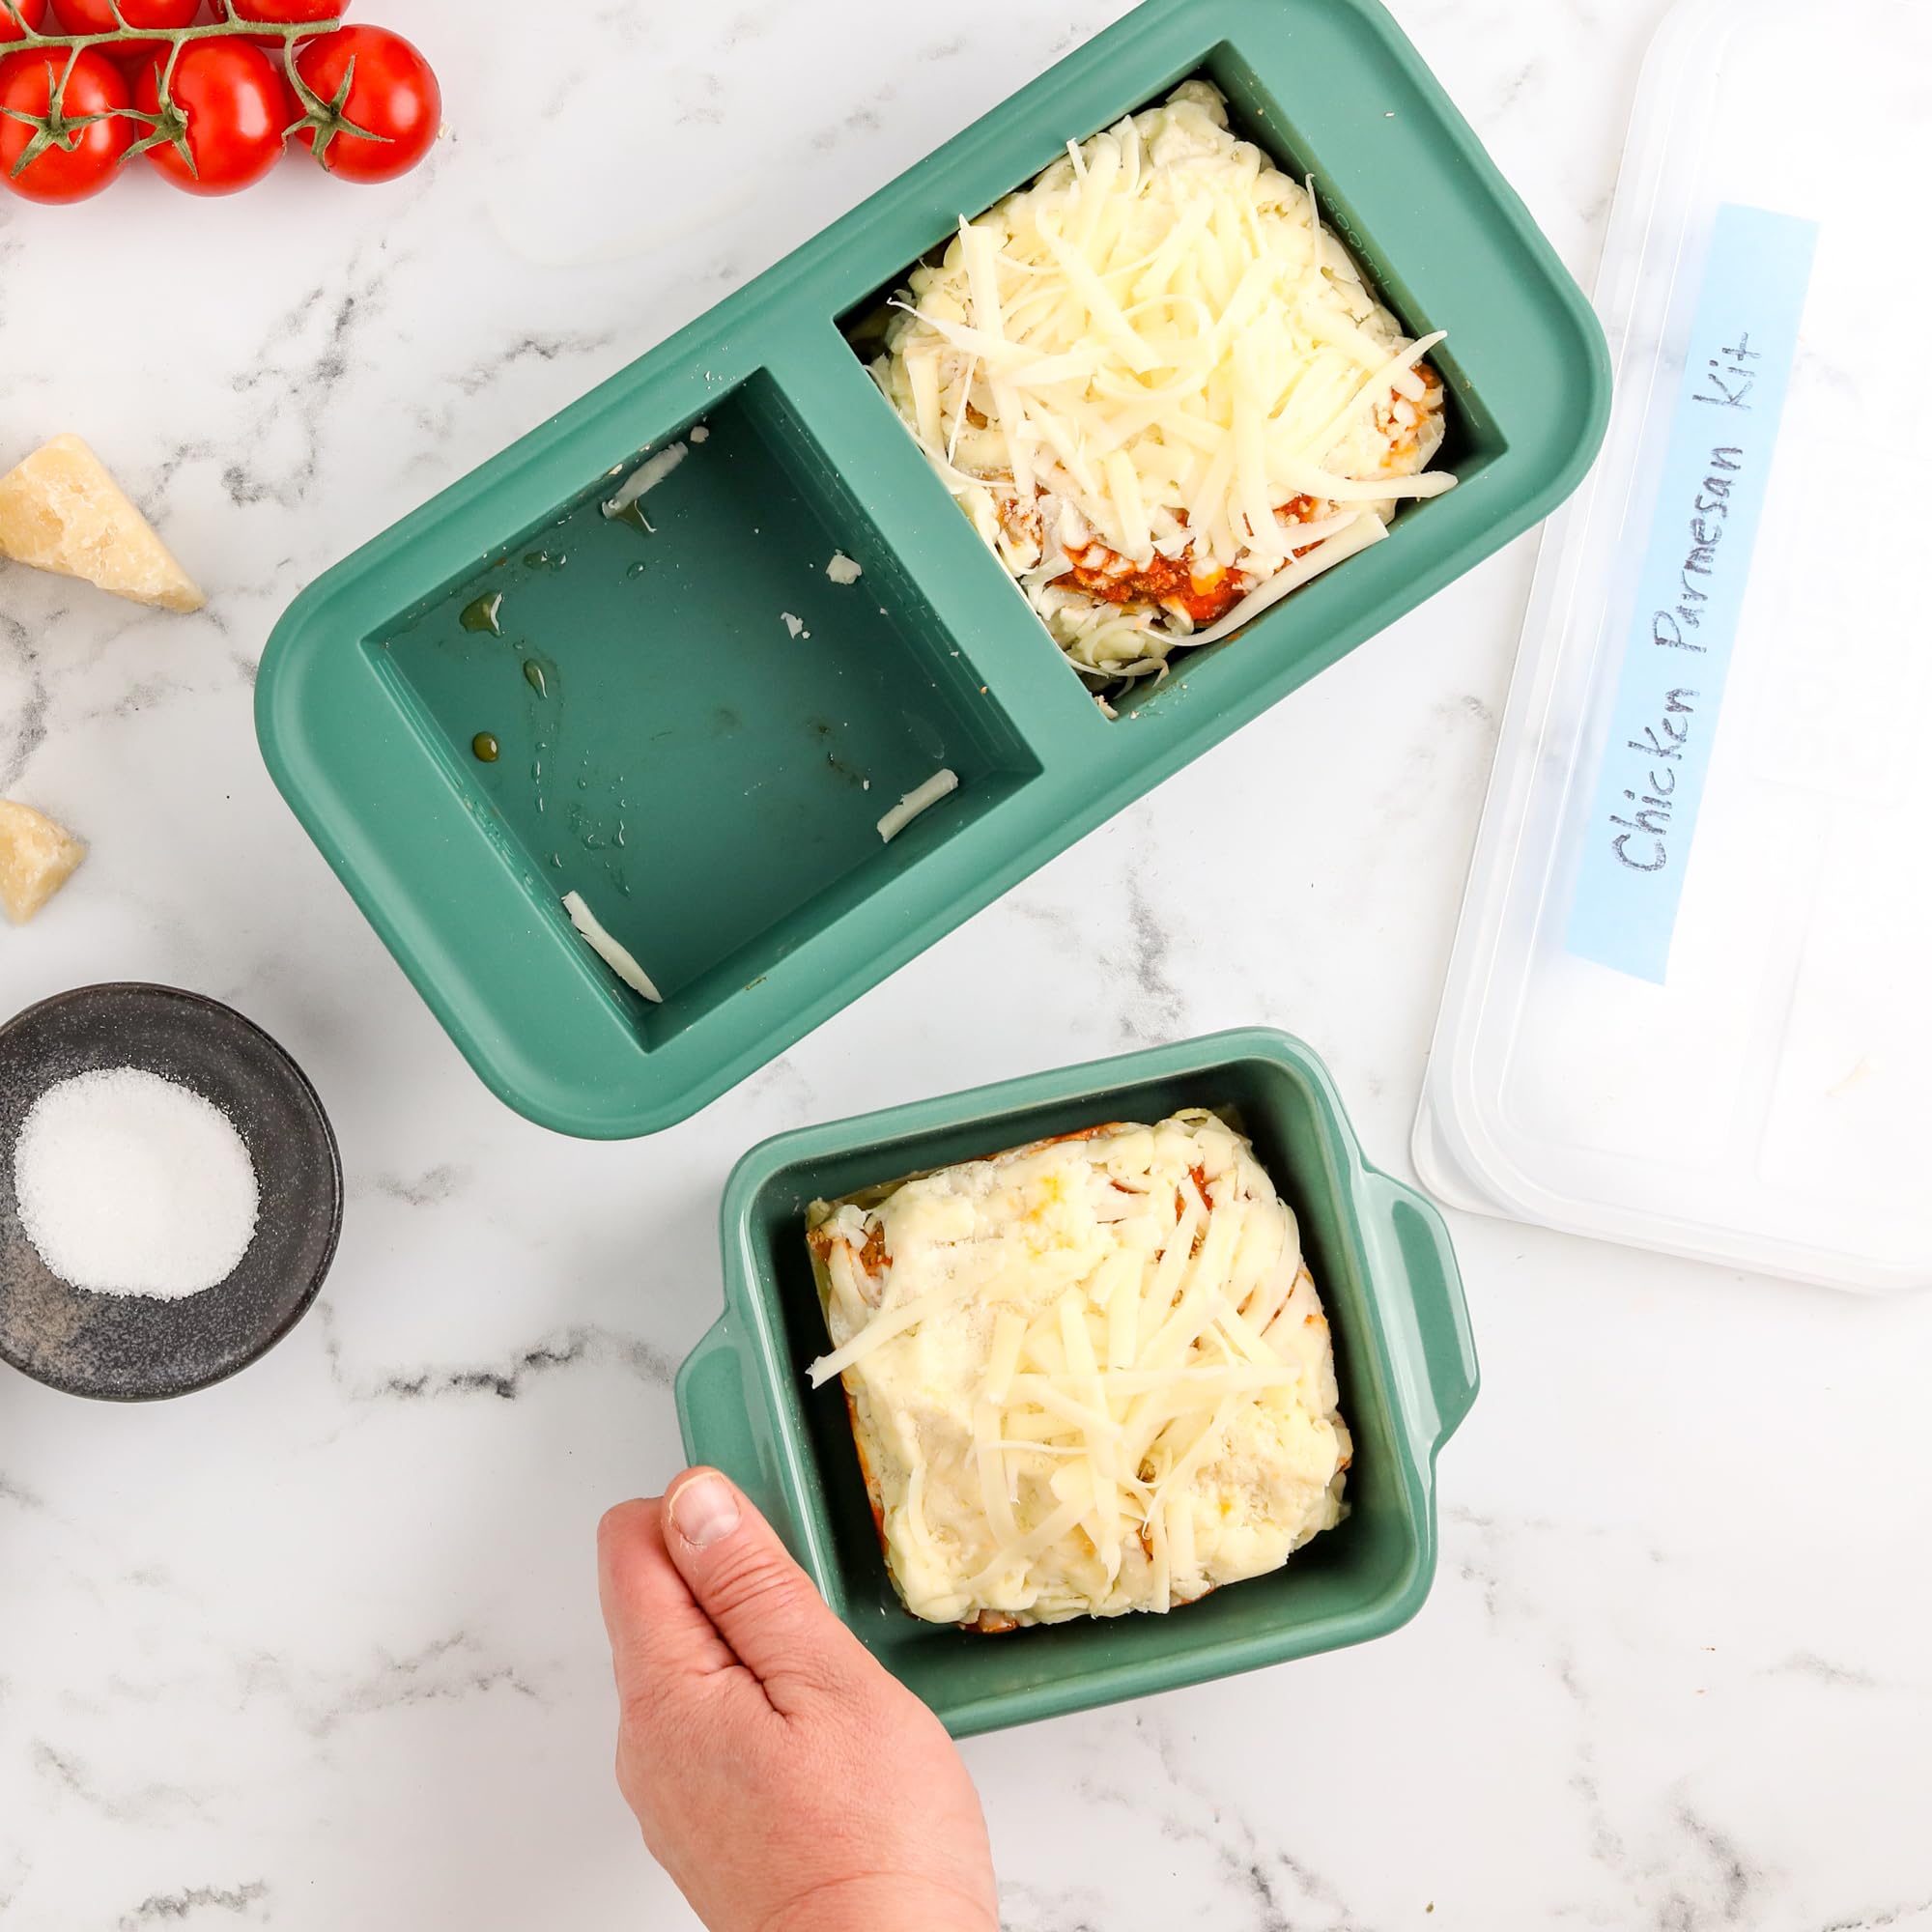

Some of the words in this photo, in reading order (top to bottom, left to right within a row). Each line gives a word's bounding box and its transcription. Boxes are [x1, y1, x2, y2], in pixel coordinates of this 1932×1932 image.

[1692, 331, 1762, 412] Kit
[1652, 446, 1744, 654] Parmesan
[1608, 687, 1700, 871] Chicken
